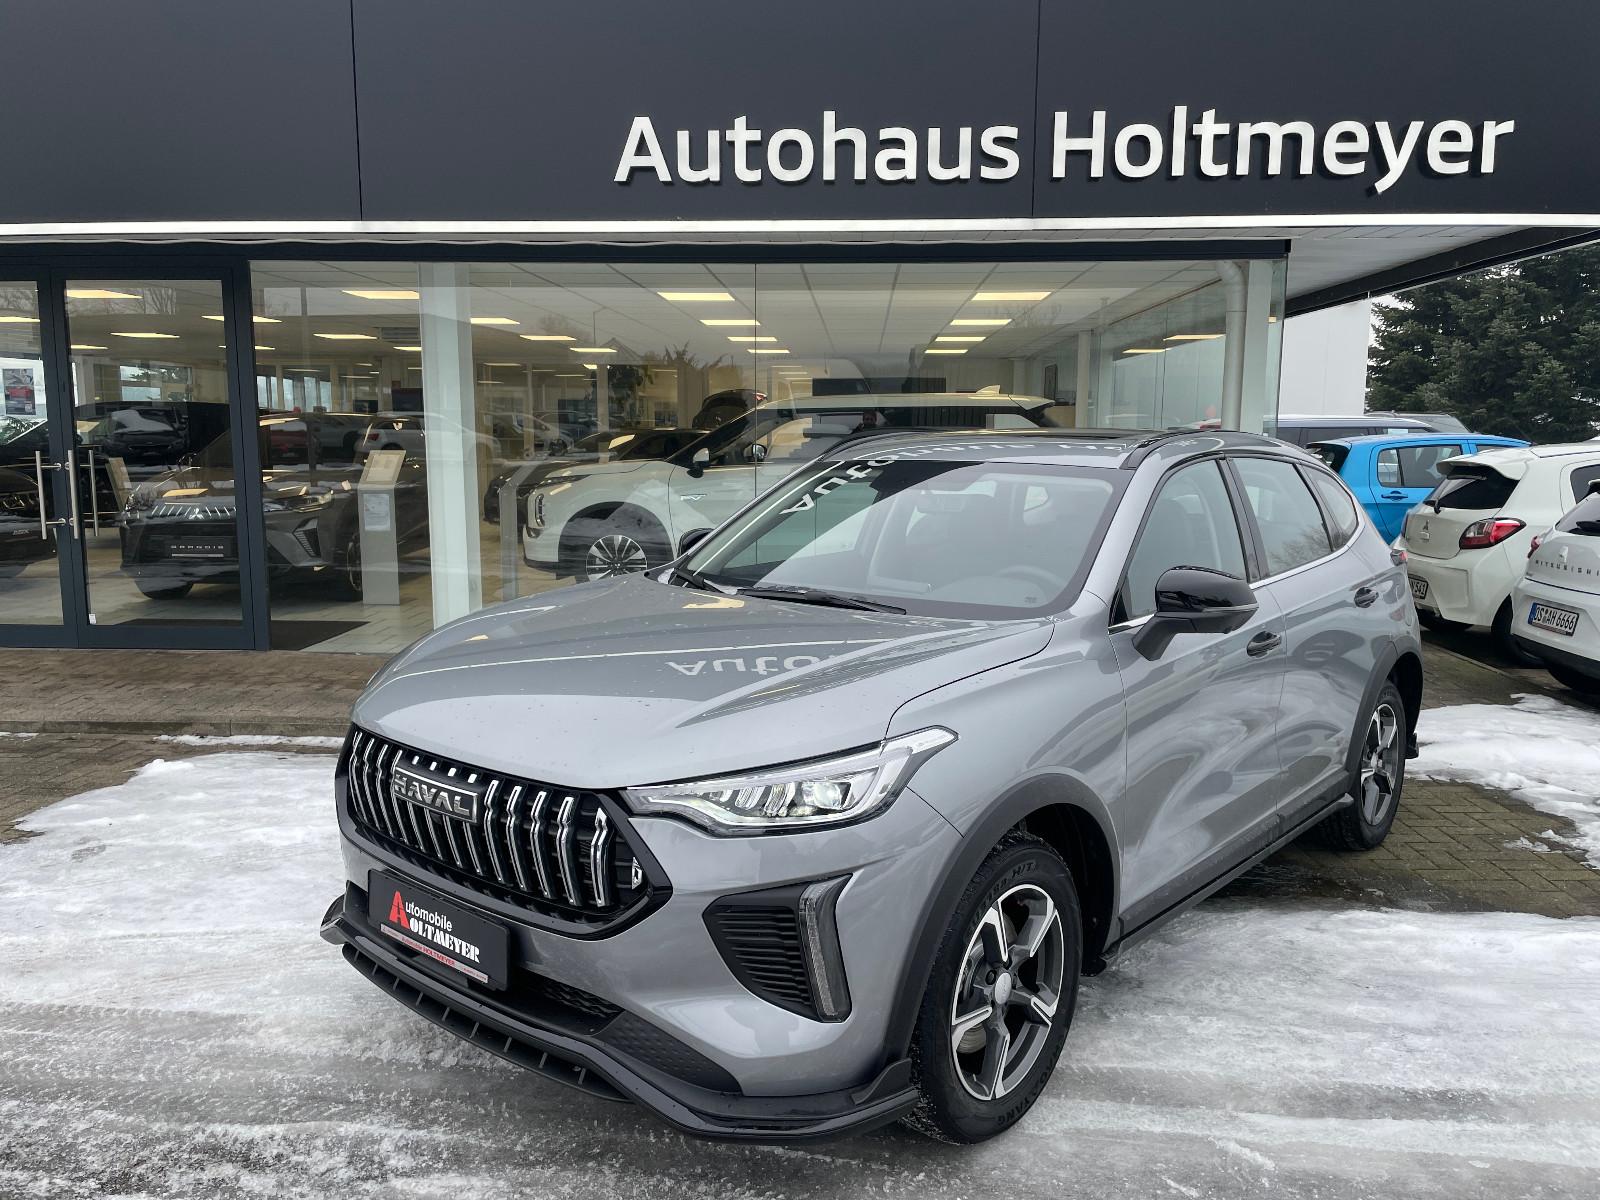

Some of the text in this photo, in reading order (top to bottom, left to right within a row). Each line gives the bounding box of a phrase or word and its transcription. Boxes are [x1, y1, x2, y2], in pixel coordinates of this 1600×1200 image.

[613, 105, 1515, 194] Autohaus Holtmeyer
[394, 774, 470, 817] HAVAL
[389, 891, 453, 932] Automobile
